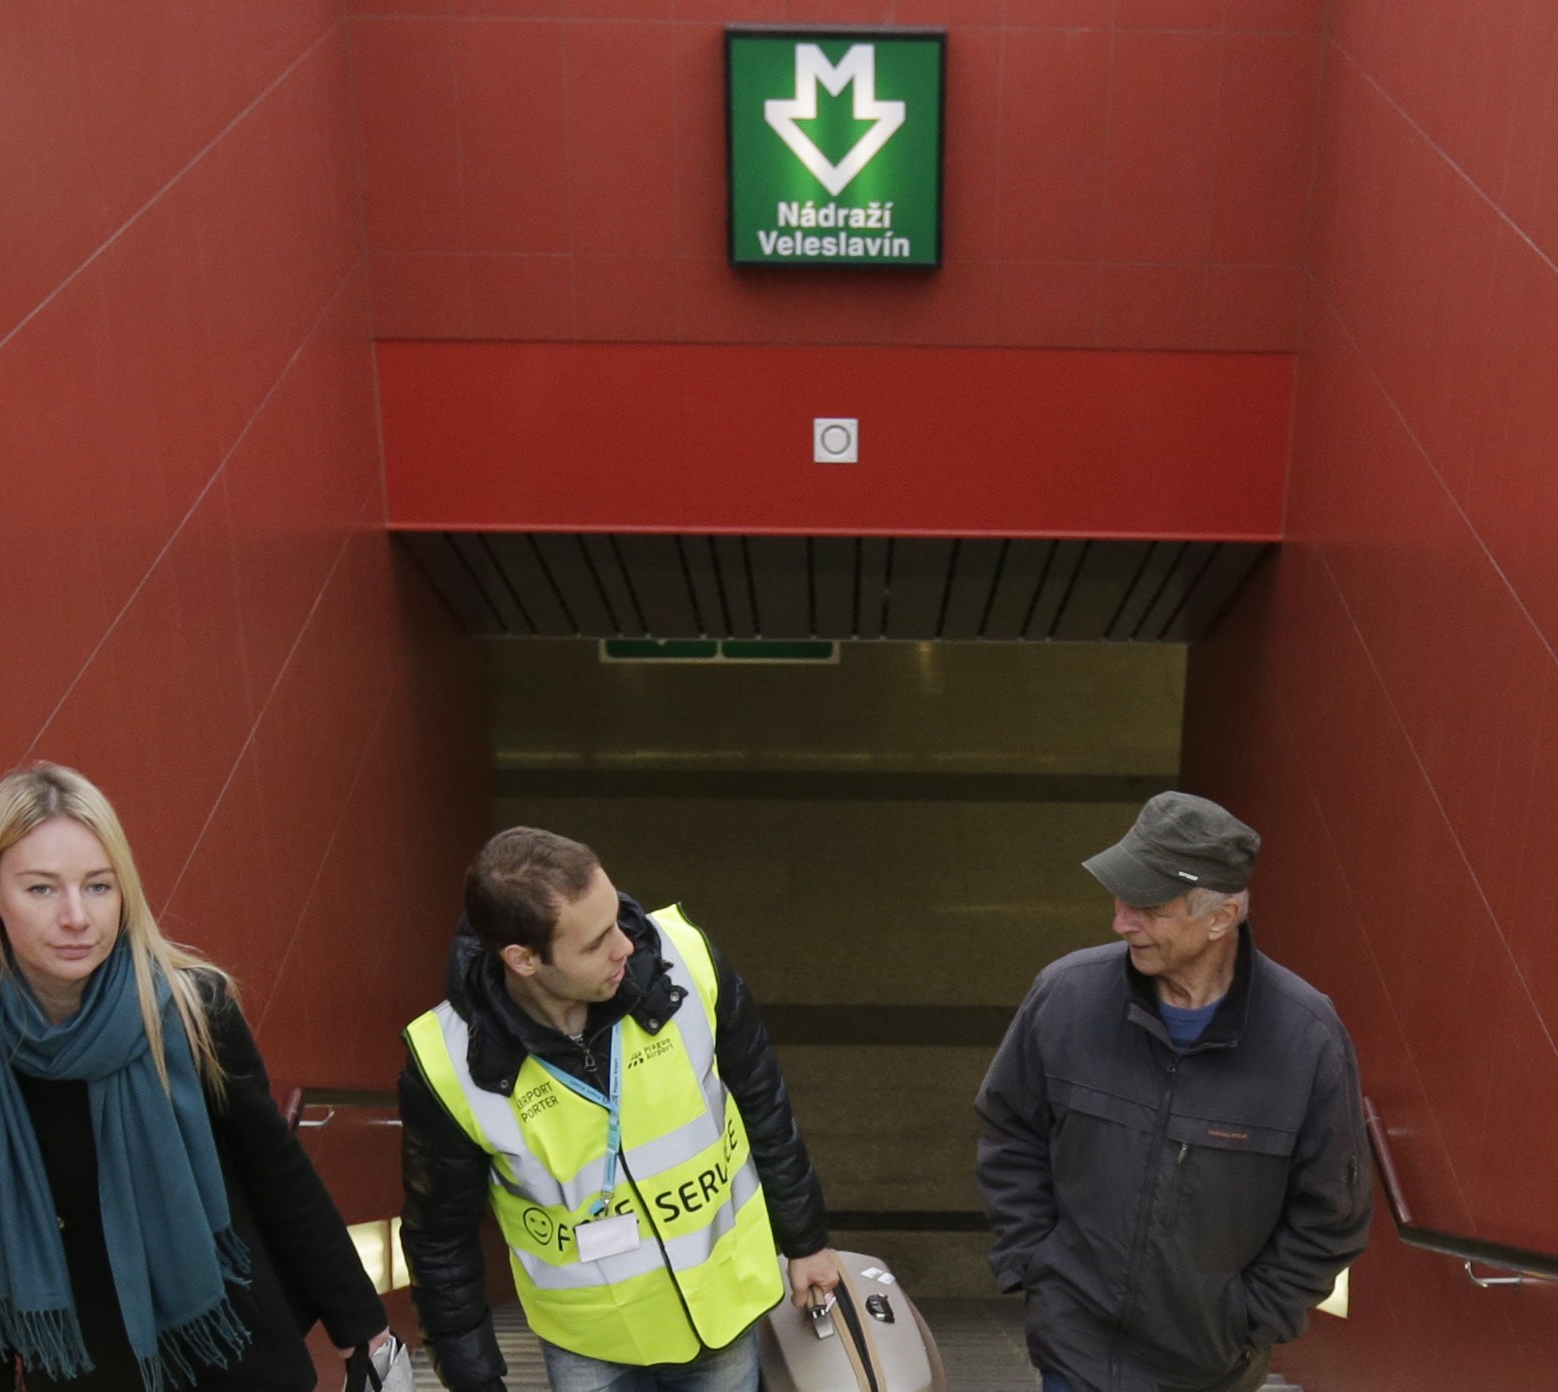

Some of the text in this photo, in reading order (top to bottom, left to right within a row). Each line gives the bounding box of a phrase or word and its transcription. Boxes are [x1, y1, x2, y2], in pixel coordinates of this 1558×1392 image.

[777, 200, 894, 228] Nádraží
[757, 231, 910, 257] Veleslavín
[521, 1095, 559, 1123] PORTER
[558, 1198, 640, 1252] FE
